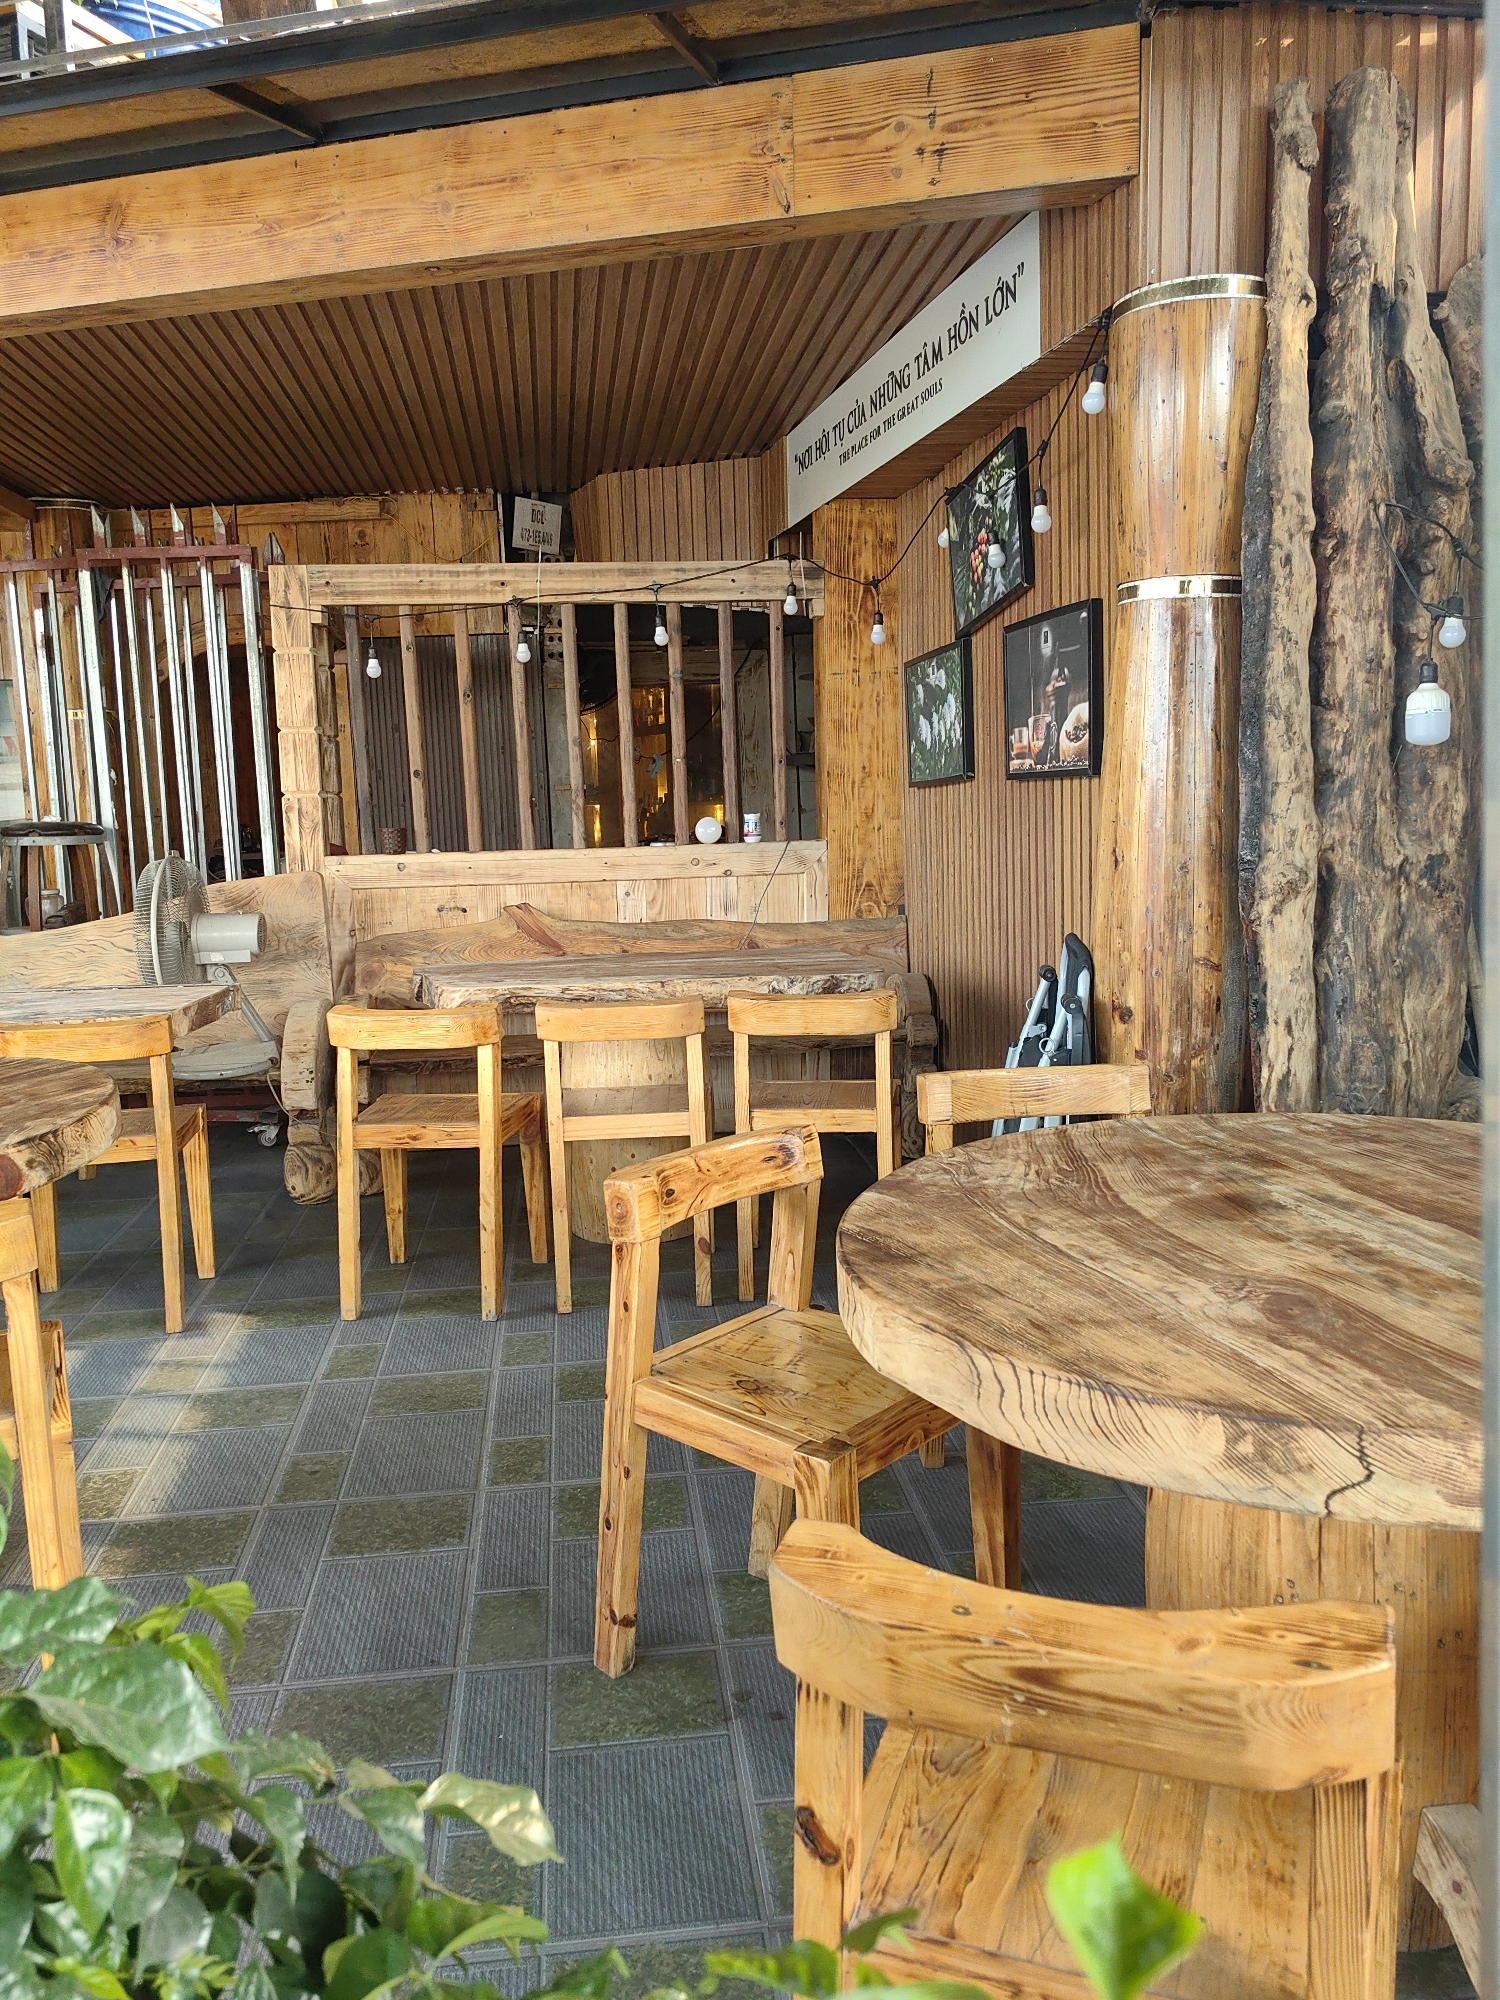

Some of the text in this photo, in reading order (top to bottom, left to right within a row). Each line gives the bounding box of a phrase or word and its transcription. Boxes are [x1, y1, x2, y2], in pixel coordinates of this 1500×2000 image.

[815, 428, 831, 461] HỘI
[832, 418, 845, 448] TỤ
[847, 399, 867, 434] CỦA
[870, 363, 911, 418] NHỮNG
[914, 335, 943, 380] TÂM
[947, 302, 980, 355] HỒN
[839, 378, 943, 466] THE PLACE FOR THE GREAT SOULS
